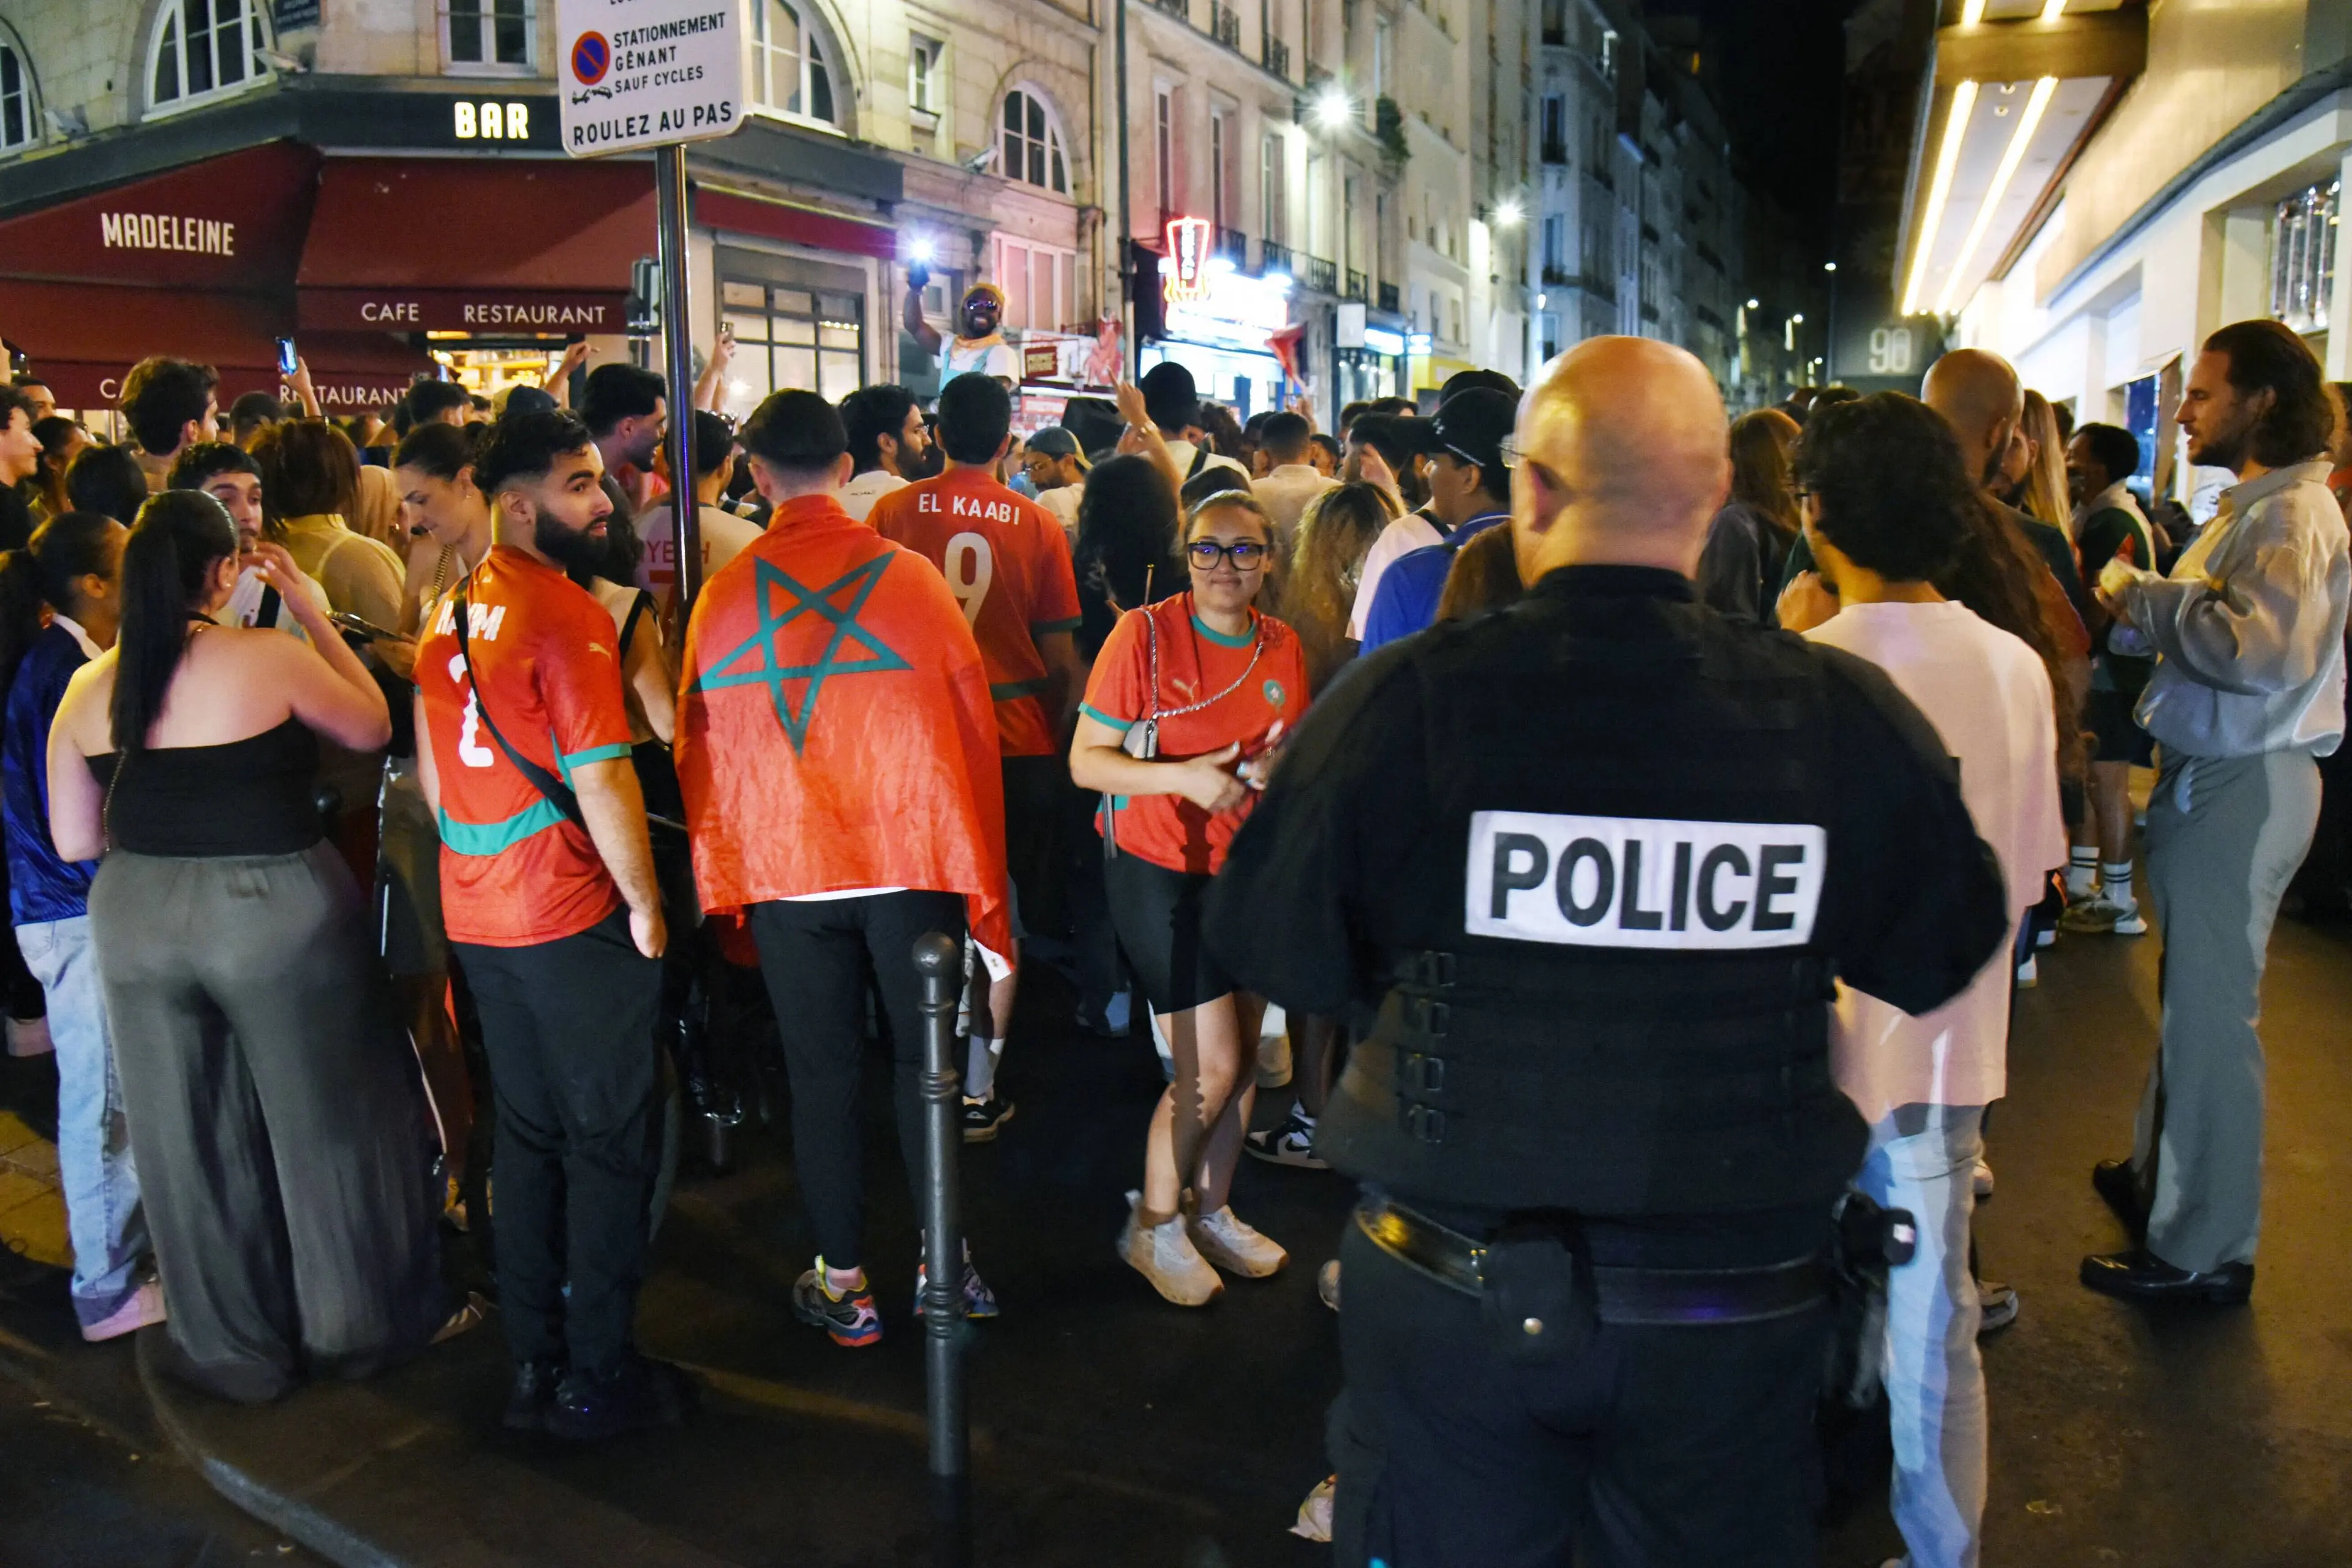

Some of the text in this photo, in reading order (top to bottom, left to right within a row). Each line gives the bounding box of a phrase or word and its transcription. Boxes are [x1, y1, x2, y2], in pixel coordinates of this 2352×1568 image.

[614, 12, 726, 48] STATIONNEMENT
[615, 46, 677, 72] GÊNANT
[615, 66, 704, 94] SAUF CYCLES
[454, 102, 529, 139] BAR
[573, 101, 732, 146] ROULEZ AU PAS
[101, 213, 235, 256] MADELEINE
[361, 303, 606, 324] CAFE RESTAURANT
[279, 384, 409, 405] RTAURANT
[919, 494, 1020, 525] EL KAABI
[944, 532, 992, 631] 9
[448, 653, 494, 767] 2
[1490, 832, 1806, 932] POLICE
